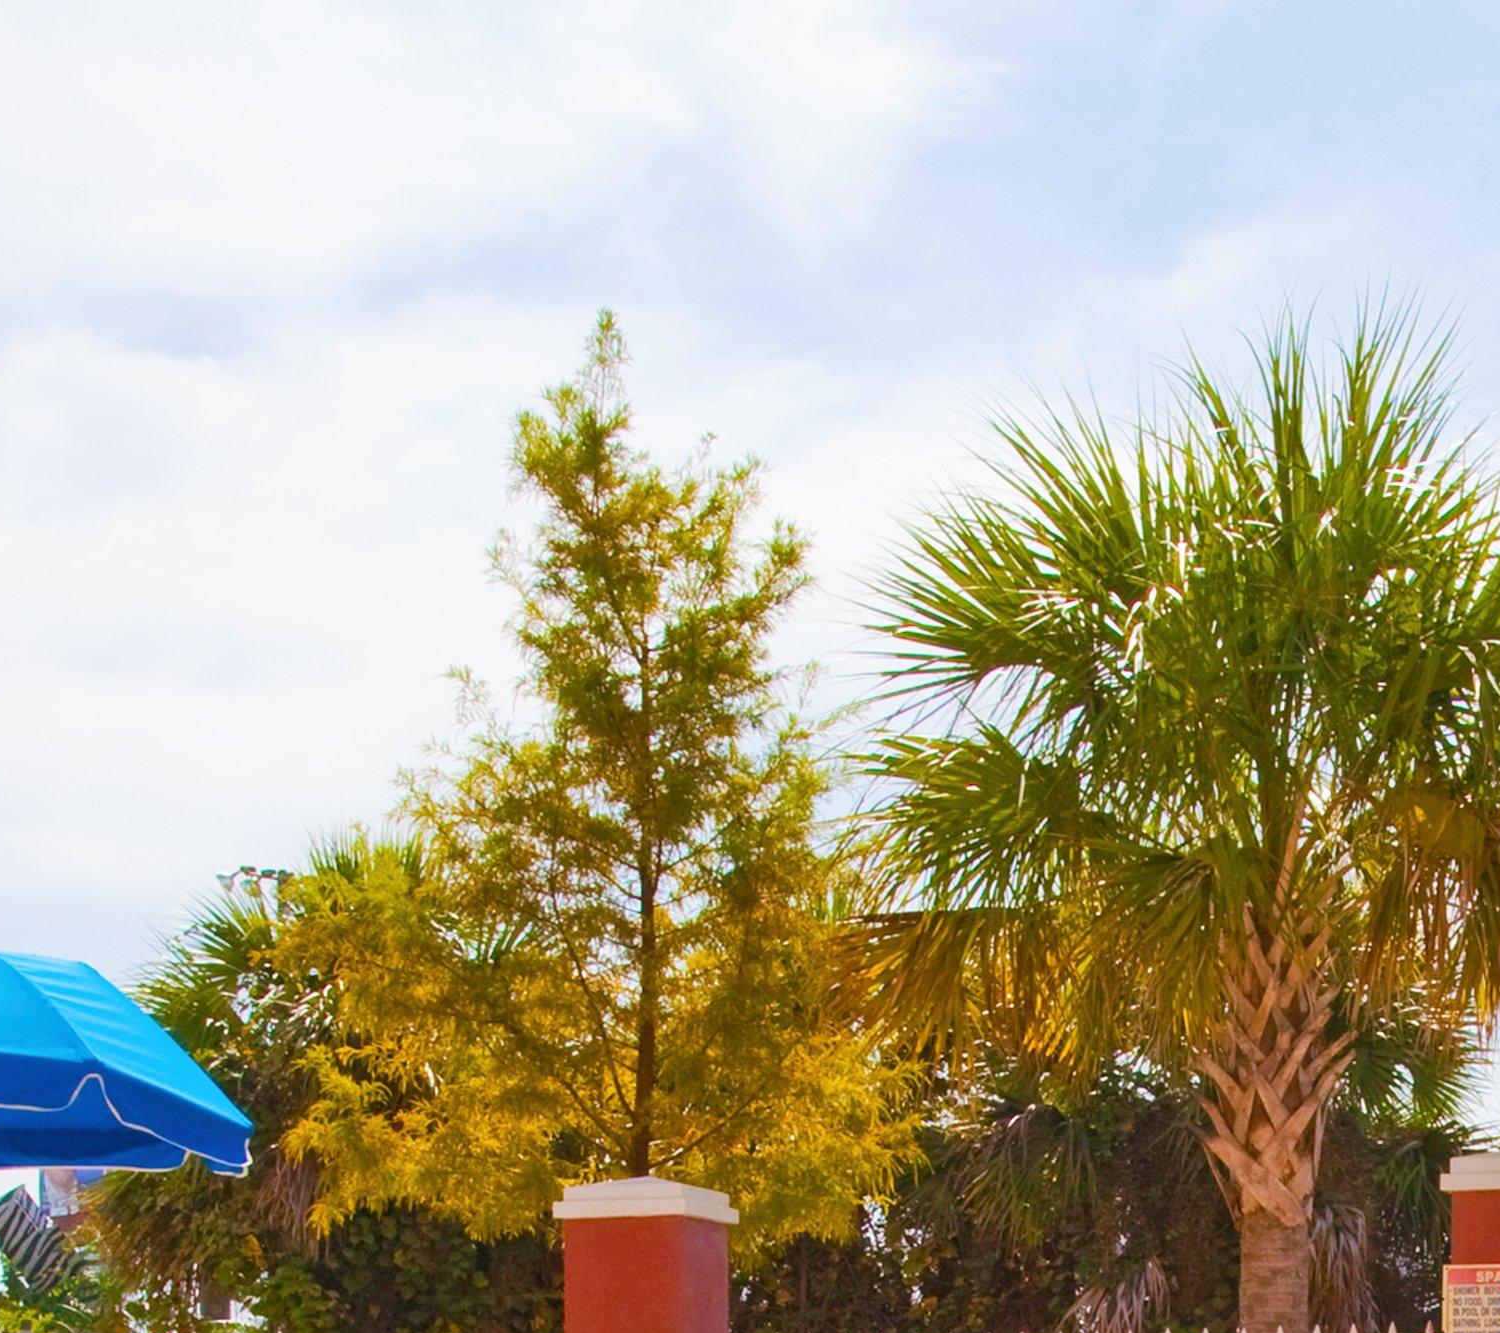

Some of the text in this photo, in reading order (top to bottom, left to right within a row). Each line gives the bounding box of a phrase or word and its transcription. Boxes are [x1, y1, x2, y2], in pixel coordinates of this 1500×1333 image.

[1453, 1287, 1480, 1295] SHOWER
[1453, 1298, 1463, 1306] NO
[1453, 1308, 1460, 1316] IN
[1462, 1308, 1479, 1316] POOL
[1481, 1307, 1489, 1316] OR
[1453, 1319, 1480, 1327] BATHING
